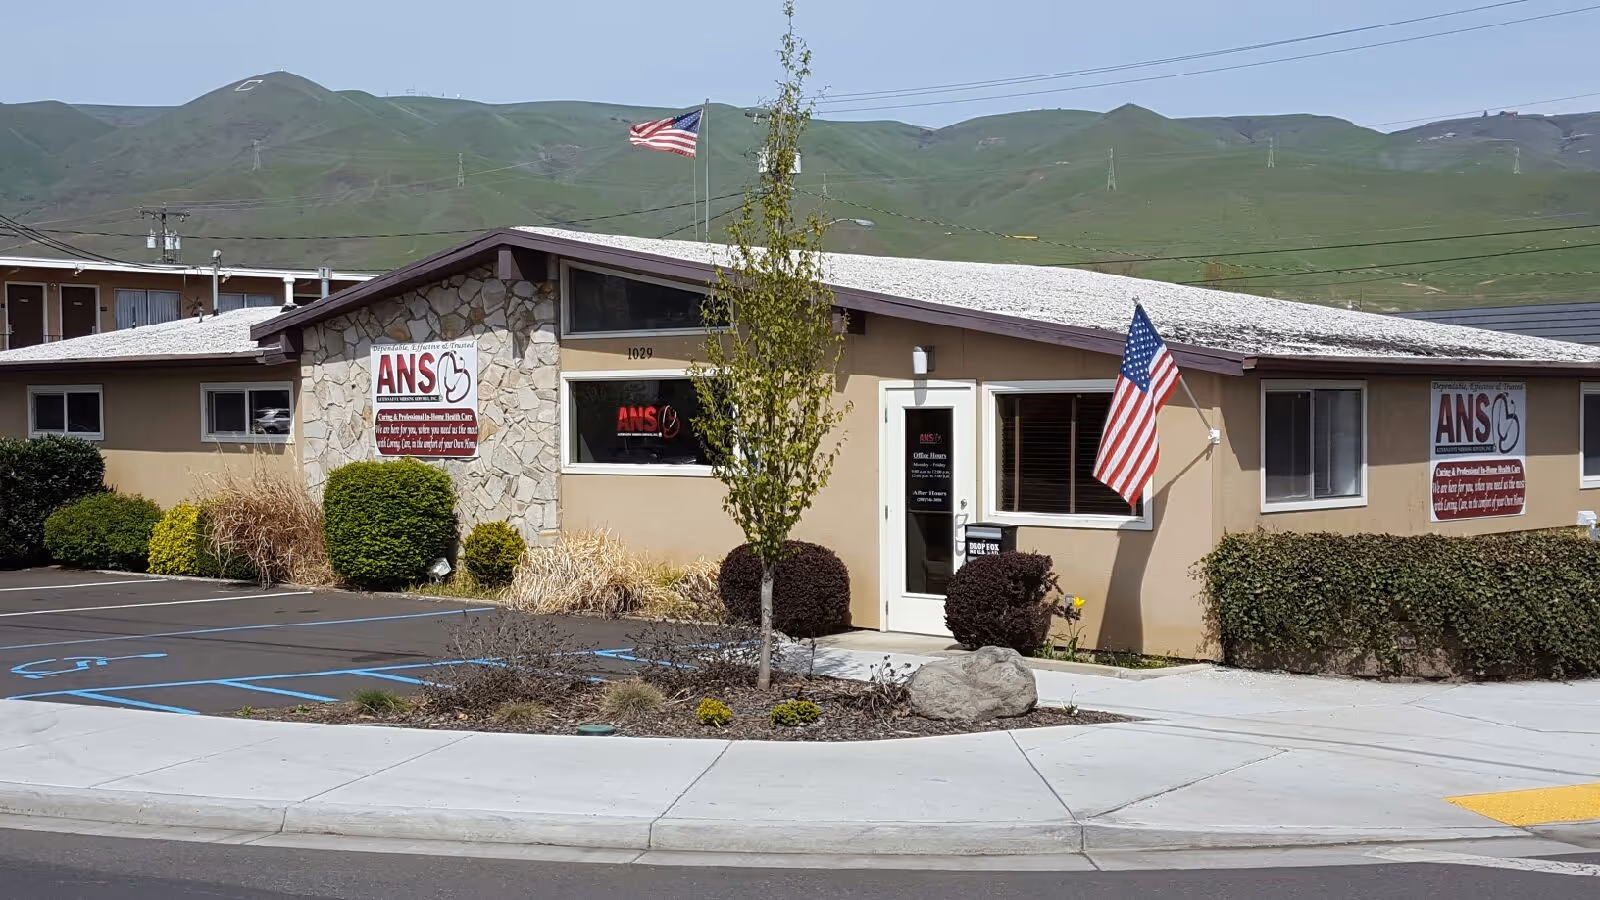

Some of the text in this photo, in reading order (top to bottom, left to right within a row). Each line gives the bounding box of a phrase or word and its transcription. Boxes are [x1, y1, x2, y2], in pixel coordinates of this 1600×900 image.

[373, 345, 409, 353] Dependable,
[412, 344, 440, 352] Effective
[627, 347, 653, 360] 1029
[376, 352, 436, 394] ANS
[378, 413, 393, 422] Caring
[399, 413, 424, 421] Professional
[424, 413, 444, 421] In-Home
[444, 413, 461, 421] Health
[461, 413, 473, 421] Care
[617, 406, 658, 432] ANS
[1435, 393, 1490, 443] ANS
[374, 424, 382, 434] We
[390, 423, 400, 434] here
[399, 423, 407, 438] for
[418, 423, 429, 434] when
[431, 427, 440, 438] you
[440, 423, 452, 434] need
[467, 426, 478, 434] most
[377, 437, 386, 448] with
[424, 437, 438, 452] comfort
[453, 438, 464, 449] Own
[913, 452, 947, 460] Office Hours
[1436, 468, 1451, 477] Caring
[1456, 466, 1480, 476] Professional
[1480, 466, 1497, 475] In-Home
[1497, 465, 1511, 475] Health
[1511, 464, 1520, 474] Care
[1432, 480, 1440, 494] We
[1448, 479, 1457, 493] here
[1456, 478, 1465, 497] for
[1475, 478, 1485, 492] when
[1485, 482, 1493, 496] you
[1494, 476, 1504, 490] need
[1504, 495, 1513, 507] Own
[969, 543, 999, 551] DROP BOX
